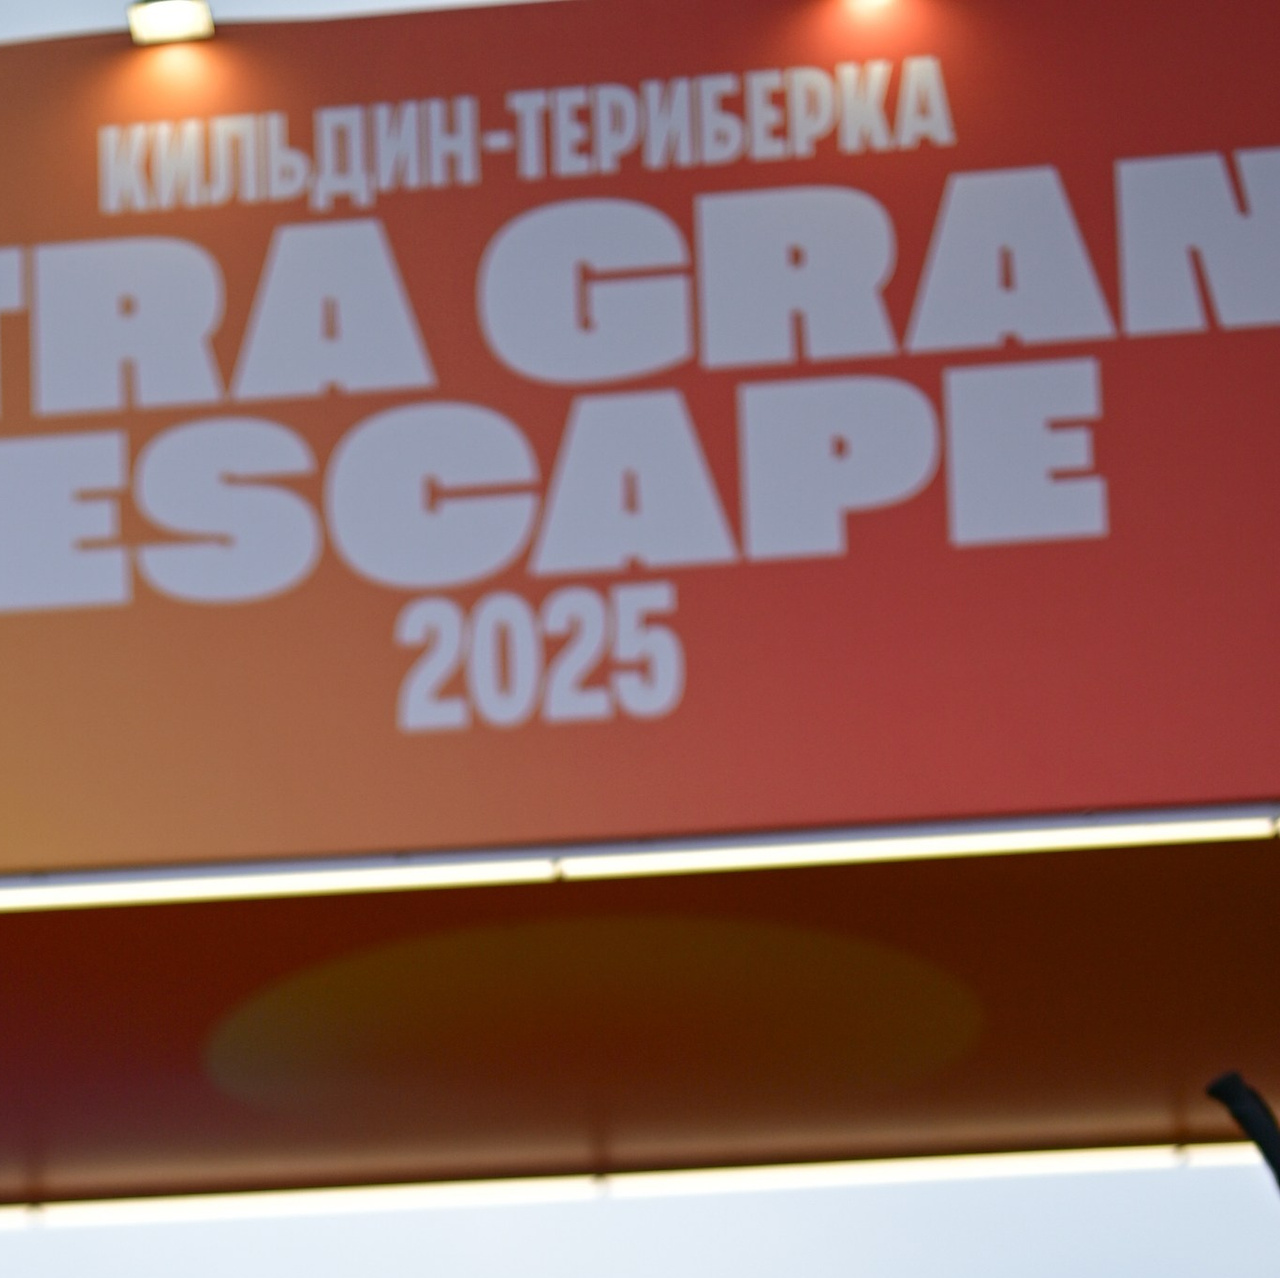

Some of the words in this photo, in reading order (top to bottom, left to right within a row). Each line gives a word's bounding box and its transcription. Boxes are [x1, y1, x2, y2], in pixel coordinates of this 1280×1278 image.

[97, 55, 957, 214] КИЛЬДИН-ТЕРИБЕРКА
[476, 145, 1280, 386] GRAN
[397, 582, 686, 732] 2025
